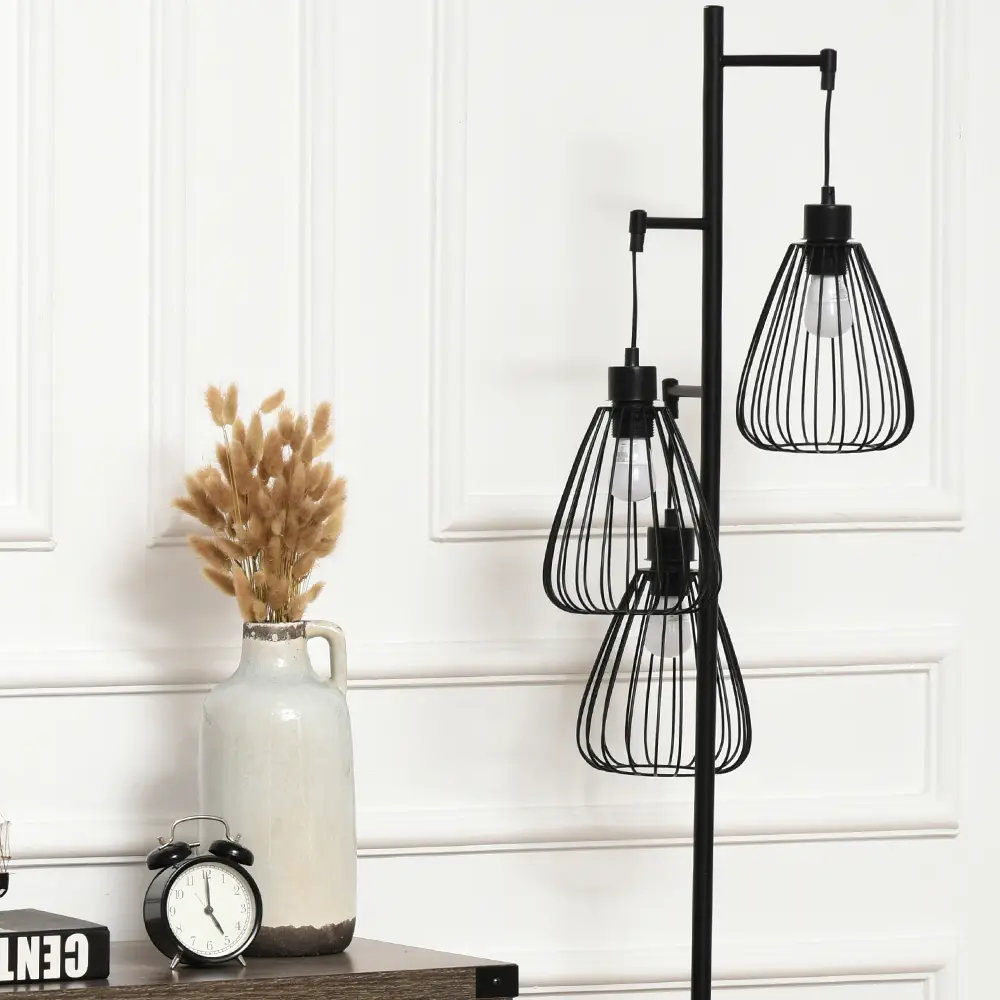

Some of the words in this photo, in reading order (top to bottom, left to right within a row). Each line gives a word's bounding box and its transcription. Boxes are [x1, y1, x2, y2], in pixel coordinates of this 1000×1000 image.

[200, 869, 211, 880] 12
[222, 874, 225, 884] 1
[187, 875, 194, 886] 11
[175, 889, 184, 899] 10
[233, 886, 240, 895] 2
[170, 906, 176, 917] 9
[240, 904, 246, 913] 3
[176, 923, 183, 933] 8
[235, 921, 241, 930] 4
[190, 936, 196, 946] 7
[206, 941, 213, 950] 6
[224, 936, 230, 945] 5
